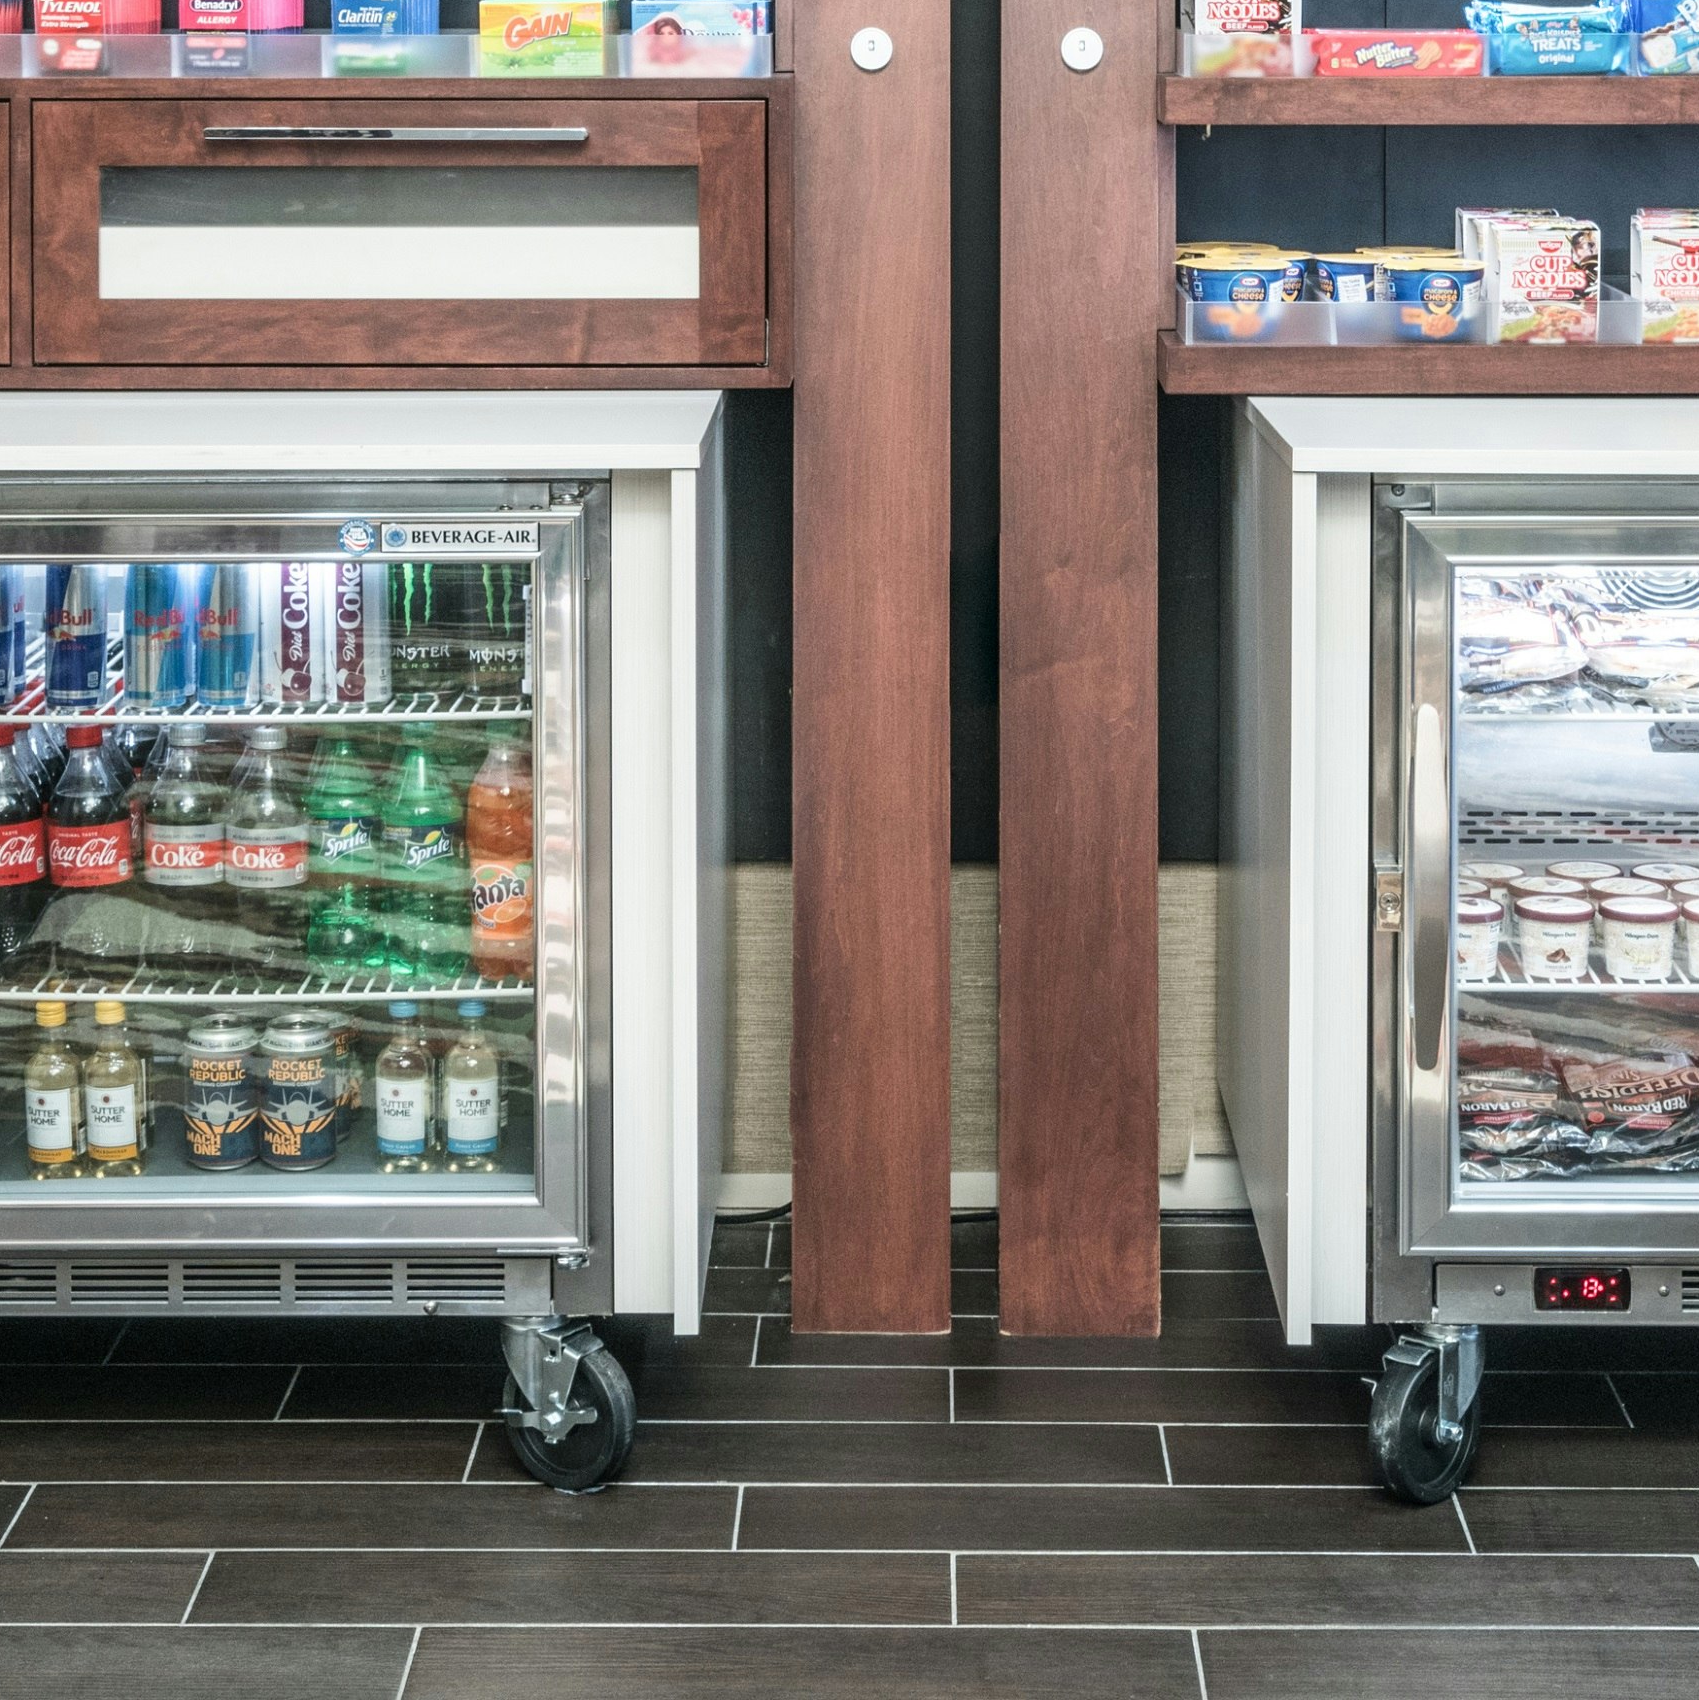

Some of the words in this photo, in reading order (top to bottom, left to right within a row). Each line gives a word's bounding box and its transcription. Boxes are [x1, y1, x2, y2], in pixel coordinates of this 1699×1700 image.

[338, 8, 384, 24] Claritin
[1207, 2, 1281, 21] NOODLES
[60, 21, 89, 30] Strength
[197, 15, 238, 24] ALLERGY
[1226, 21, 1247, 31] BEEF
[1356, 41, 1395, 64] Nutter
[1531, 38, 1582, 52] TREATS
[1376, 47, 1415, 66] Butter
[1538, 53, 1576, 66] Original
[1530, 255, 1571, 272] CUP
[1512, 270, 1587, 289] NOODLES
[1232, 292, 1265, 301] Cheese
[1530, 290, 1553, 299] BEEF
[412, 530, 533, 544] BEVERAGE-AIR
[282, 562, 309, 630] Coke
[337, 562, 362, 630] Coke
[61, 608, 93, 625] Bull
[134, 610, 168, 627] Red
[207, 608, 239, 626] Bull
[289, 631, 303, 662] Diet
[342, 631, 356, 662] Diet
[323, 829, 368, 857] Sprite
[51, 834, 119, 868] Coca-Cola
[151, 844, 205, 867] Coke
[232, 845, 286, 869] Coke
[406, 837, 450, 865] Sprite
[192, 1058, 242, 1071] ROCKET
[272, 1058, 323, 1071] ROCKET
[189, 1068, 247, 1083] REPUBLIC
[268, 1067, 327, 1082] REPUBLIC
[90, 1104, 125, 1115] SUTTER
[455, 1098, 491, 1109] SUTTER
[1612, 1101, 1662, 1114] BARON
[1665, 1096, 1688, 1114] RED
[93, 1113, 124, 1124] HOME
[459, 1106, 489, 1117] HOME
[186, 1131, 222, 1146] MACH
[263, 1130, 301, 1145] MACH
[194, 1144, 222, 1156] ONE
[271, 1143, 301, 1156] ONE
